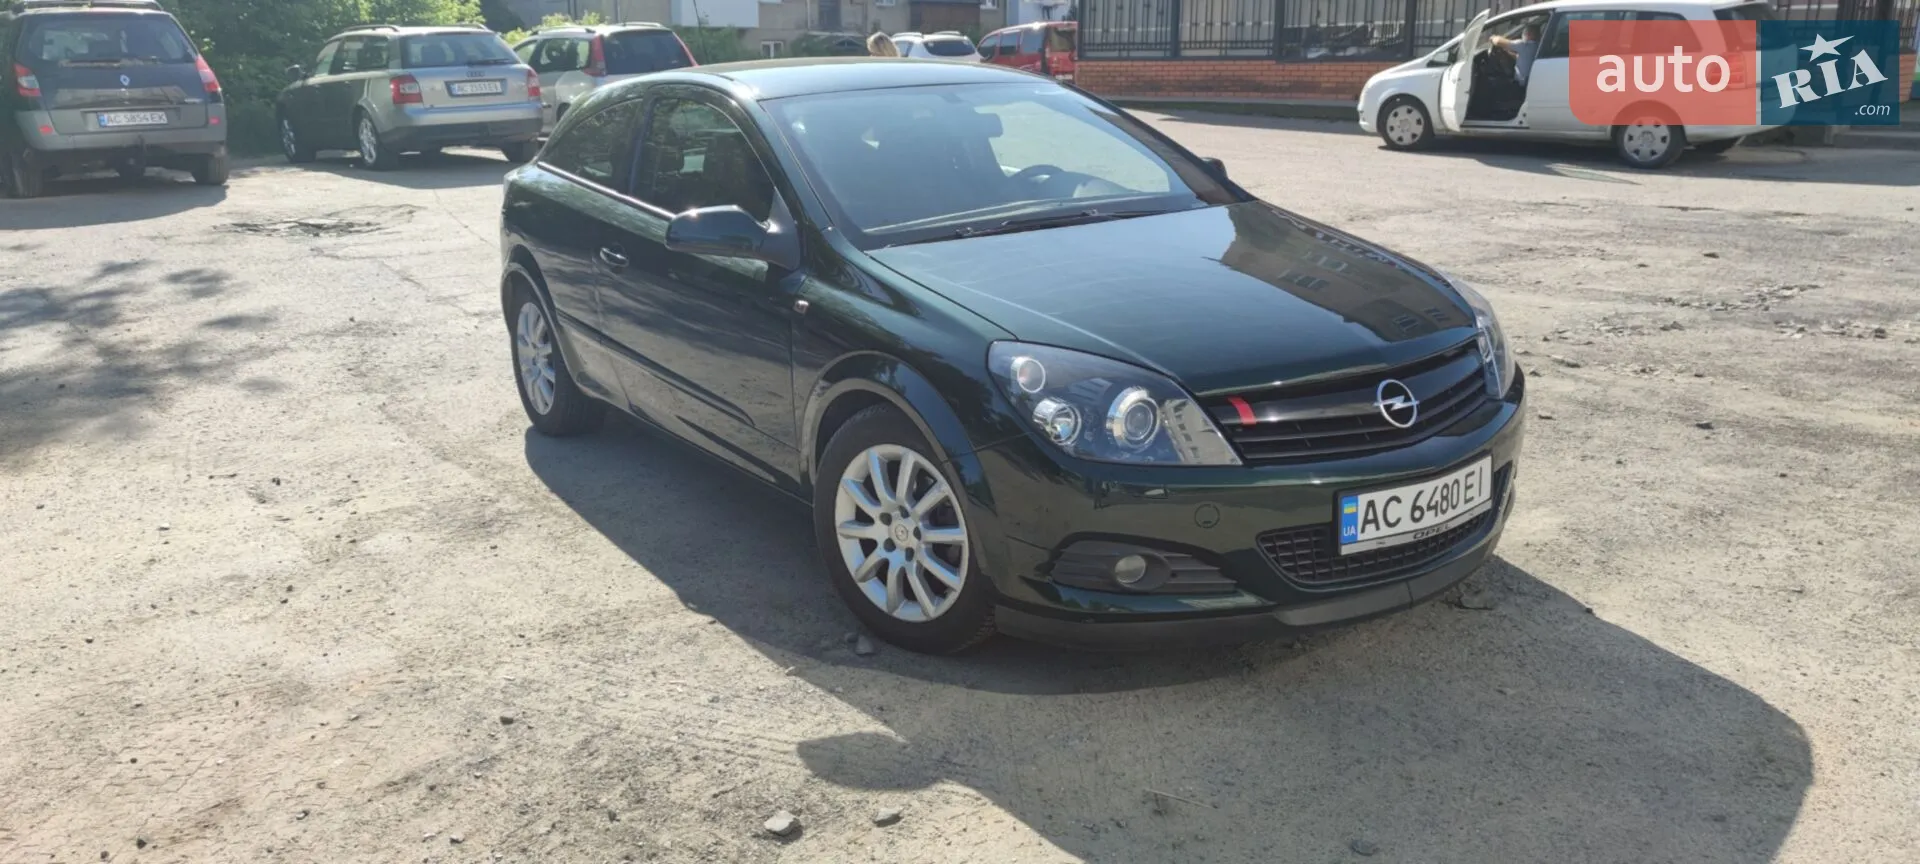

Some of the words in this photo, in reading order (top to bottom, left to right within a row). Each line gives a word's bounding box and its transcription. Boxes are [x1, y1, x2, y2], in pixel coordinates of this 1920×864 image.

[1360, 495, 1402, 534] AC
[1410, 479, 1460, 524] 6480
[1464, 466, 1482, 505] EI
[1343, 525, 1357, 537] UA
[1412, 524, 1451, 540] OPEL
